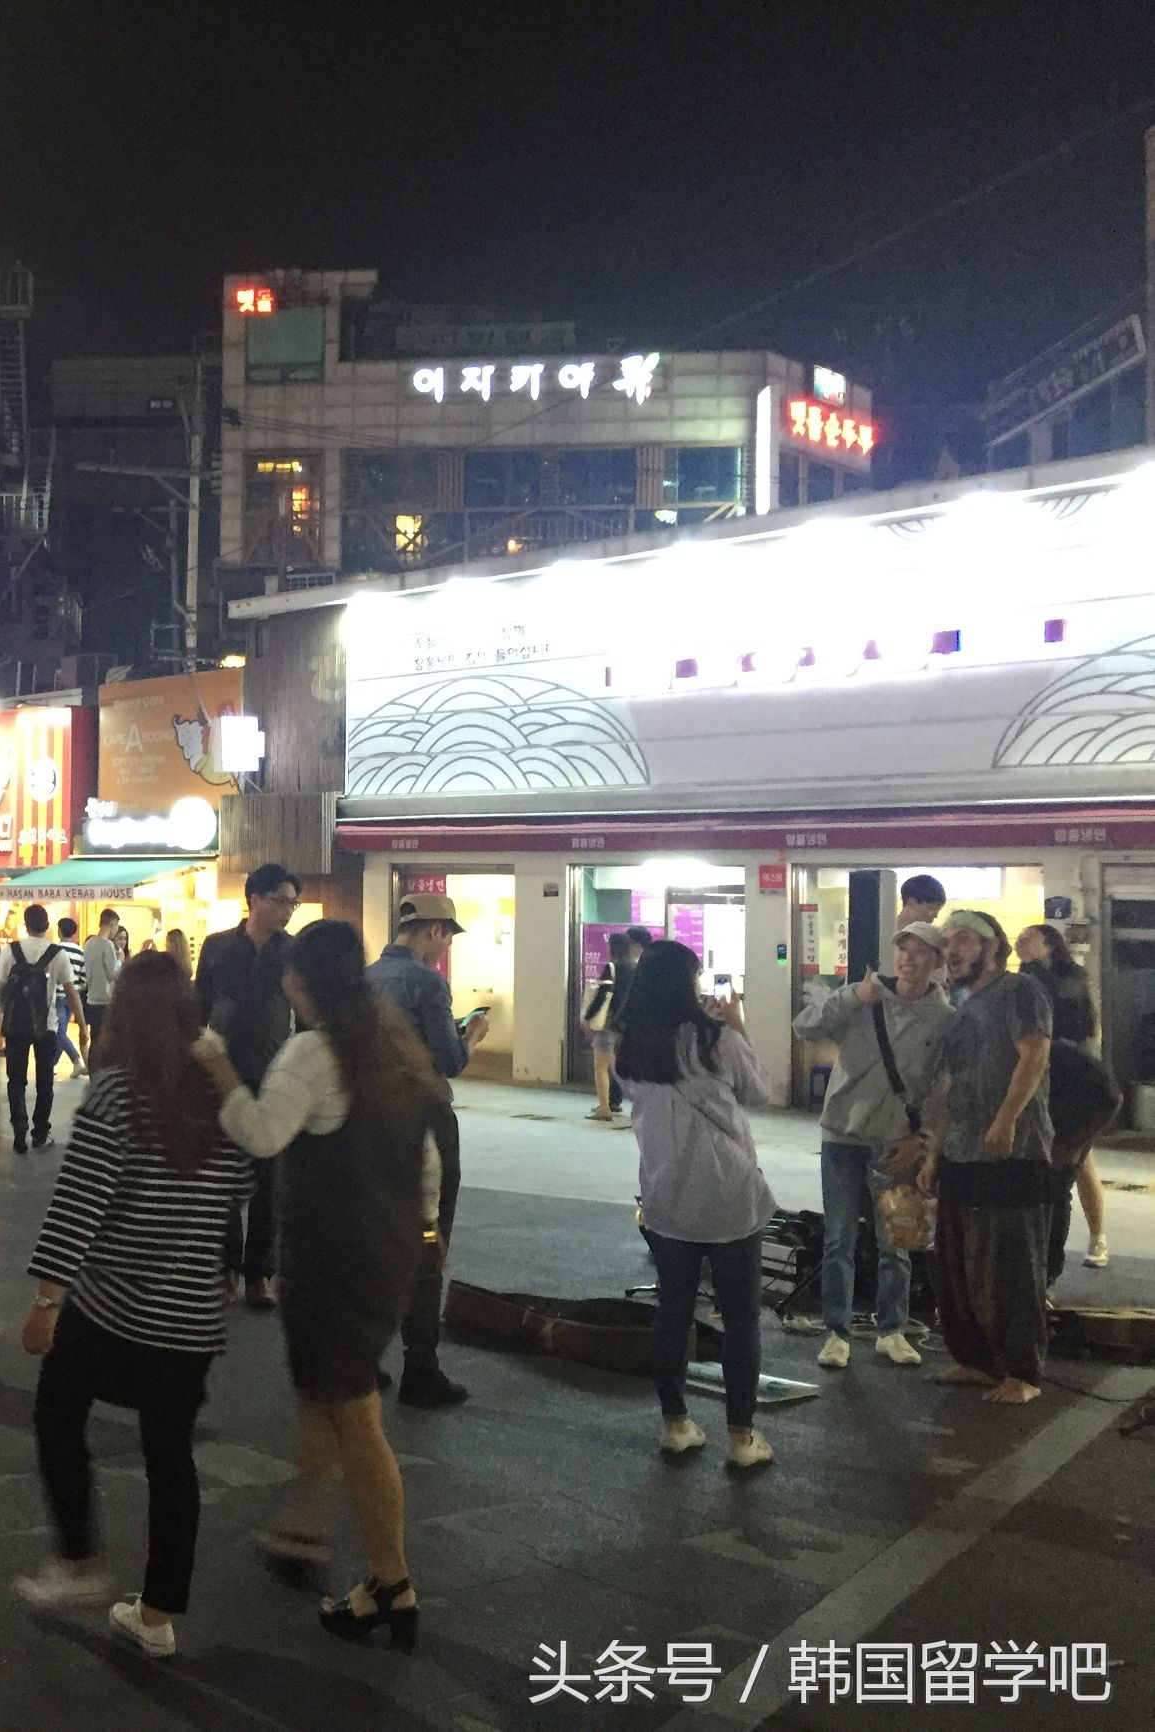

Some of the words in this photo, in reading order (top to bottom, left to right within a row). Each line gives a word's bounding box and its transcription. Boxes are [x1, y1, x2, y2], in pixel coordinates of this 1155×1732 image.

[7, 889, 34, 899] HASAN
[38, 889, 61, 899] BABA
[66, 888, 95, 899] KEBAB
[100, 887, 132, 899] HOUSE
